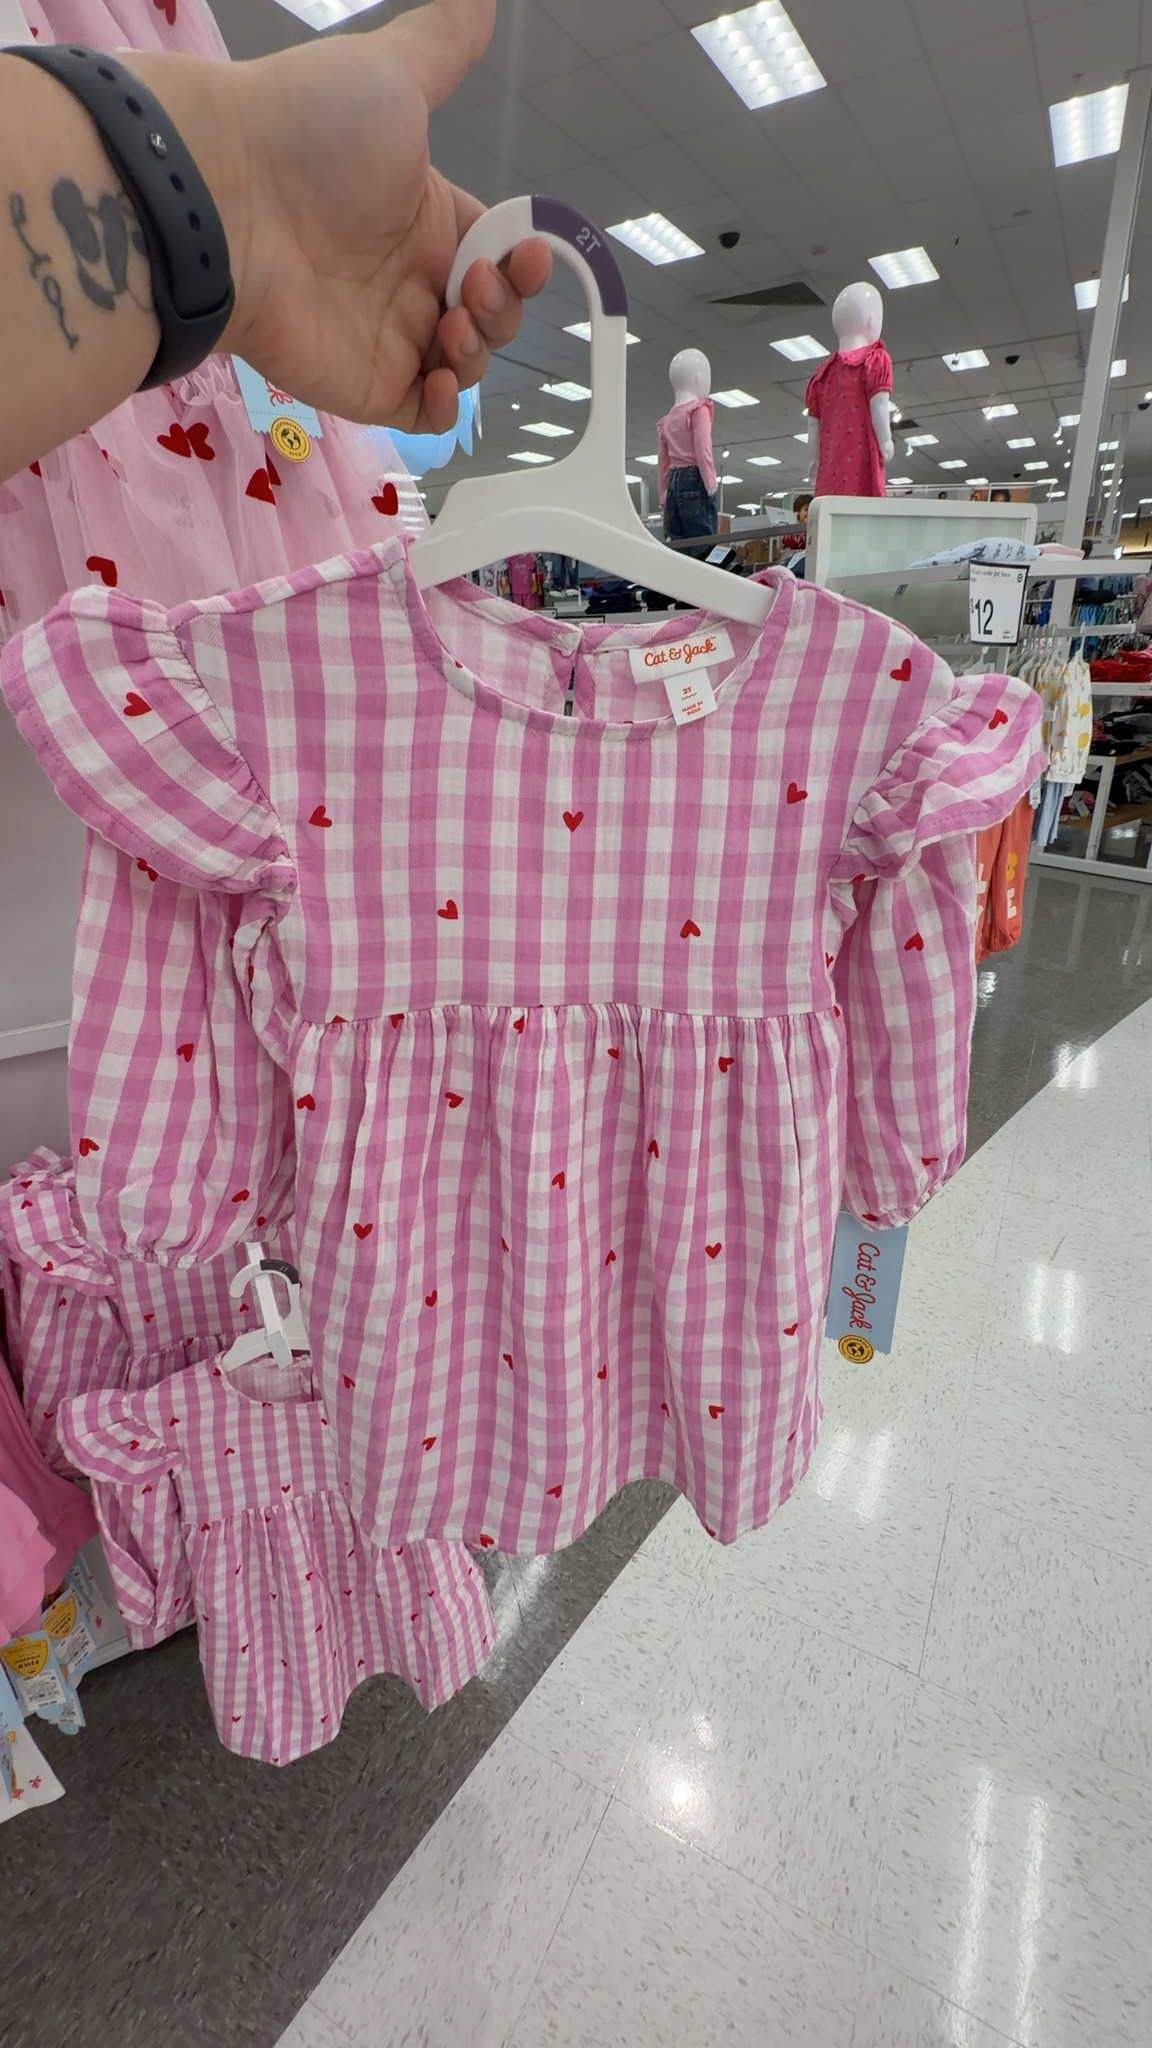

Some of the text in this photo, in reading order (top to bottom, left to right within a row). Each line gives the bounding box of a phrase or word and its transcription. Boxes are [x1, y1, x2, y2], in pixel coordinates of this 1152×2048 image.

[575, 227, 601, 252] 2T
[644, 638, 717, 667] Cat & Jack
[682, 686, 692, 695] 2T
[842, 1242, 881, 1330] Cat & Jack
